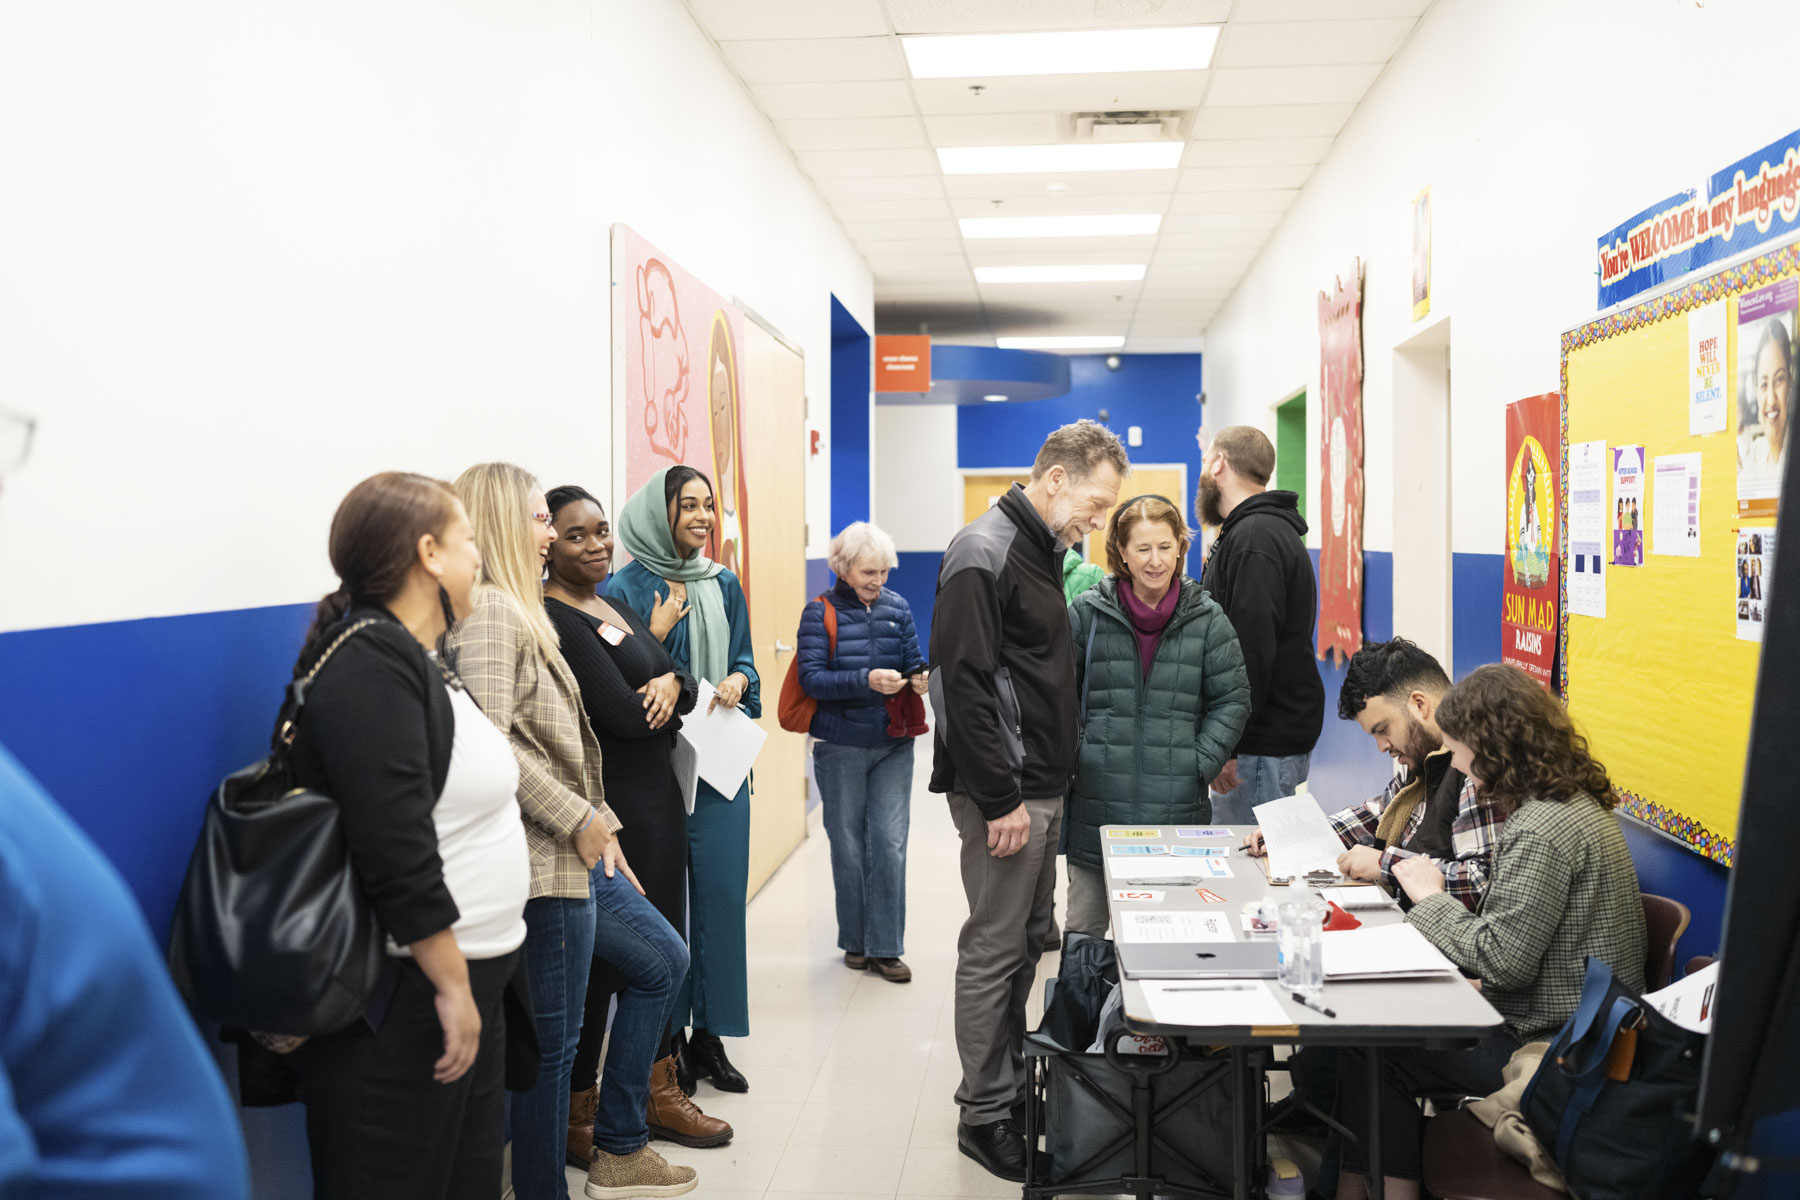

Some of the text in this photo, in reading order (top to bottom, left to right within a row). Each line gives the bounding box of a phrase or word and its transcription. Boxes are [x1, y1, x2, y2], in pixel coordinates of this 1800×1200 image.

[1601, 244, 1629, 281] You're
[1629, 206, 1695, 265] WELCOME
[1697, 207, 1709, 235] in
[1711, 196, 1735, 233] any
[1699, 336, 1718, 353] HOPE
[1699, 350, 1717, 365] WILL
[1696, 362, 1720, 379] NEVER
[1704, 376, 1713, 389] BE
[1506, 592, 1554, 632] SUN MAD
[1515, 629, 1542, 656] RAISINS
